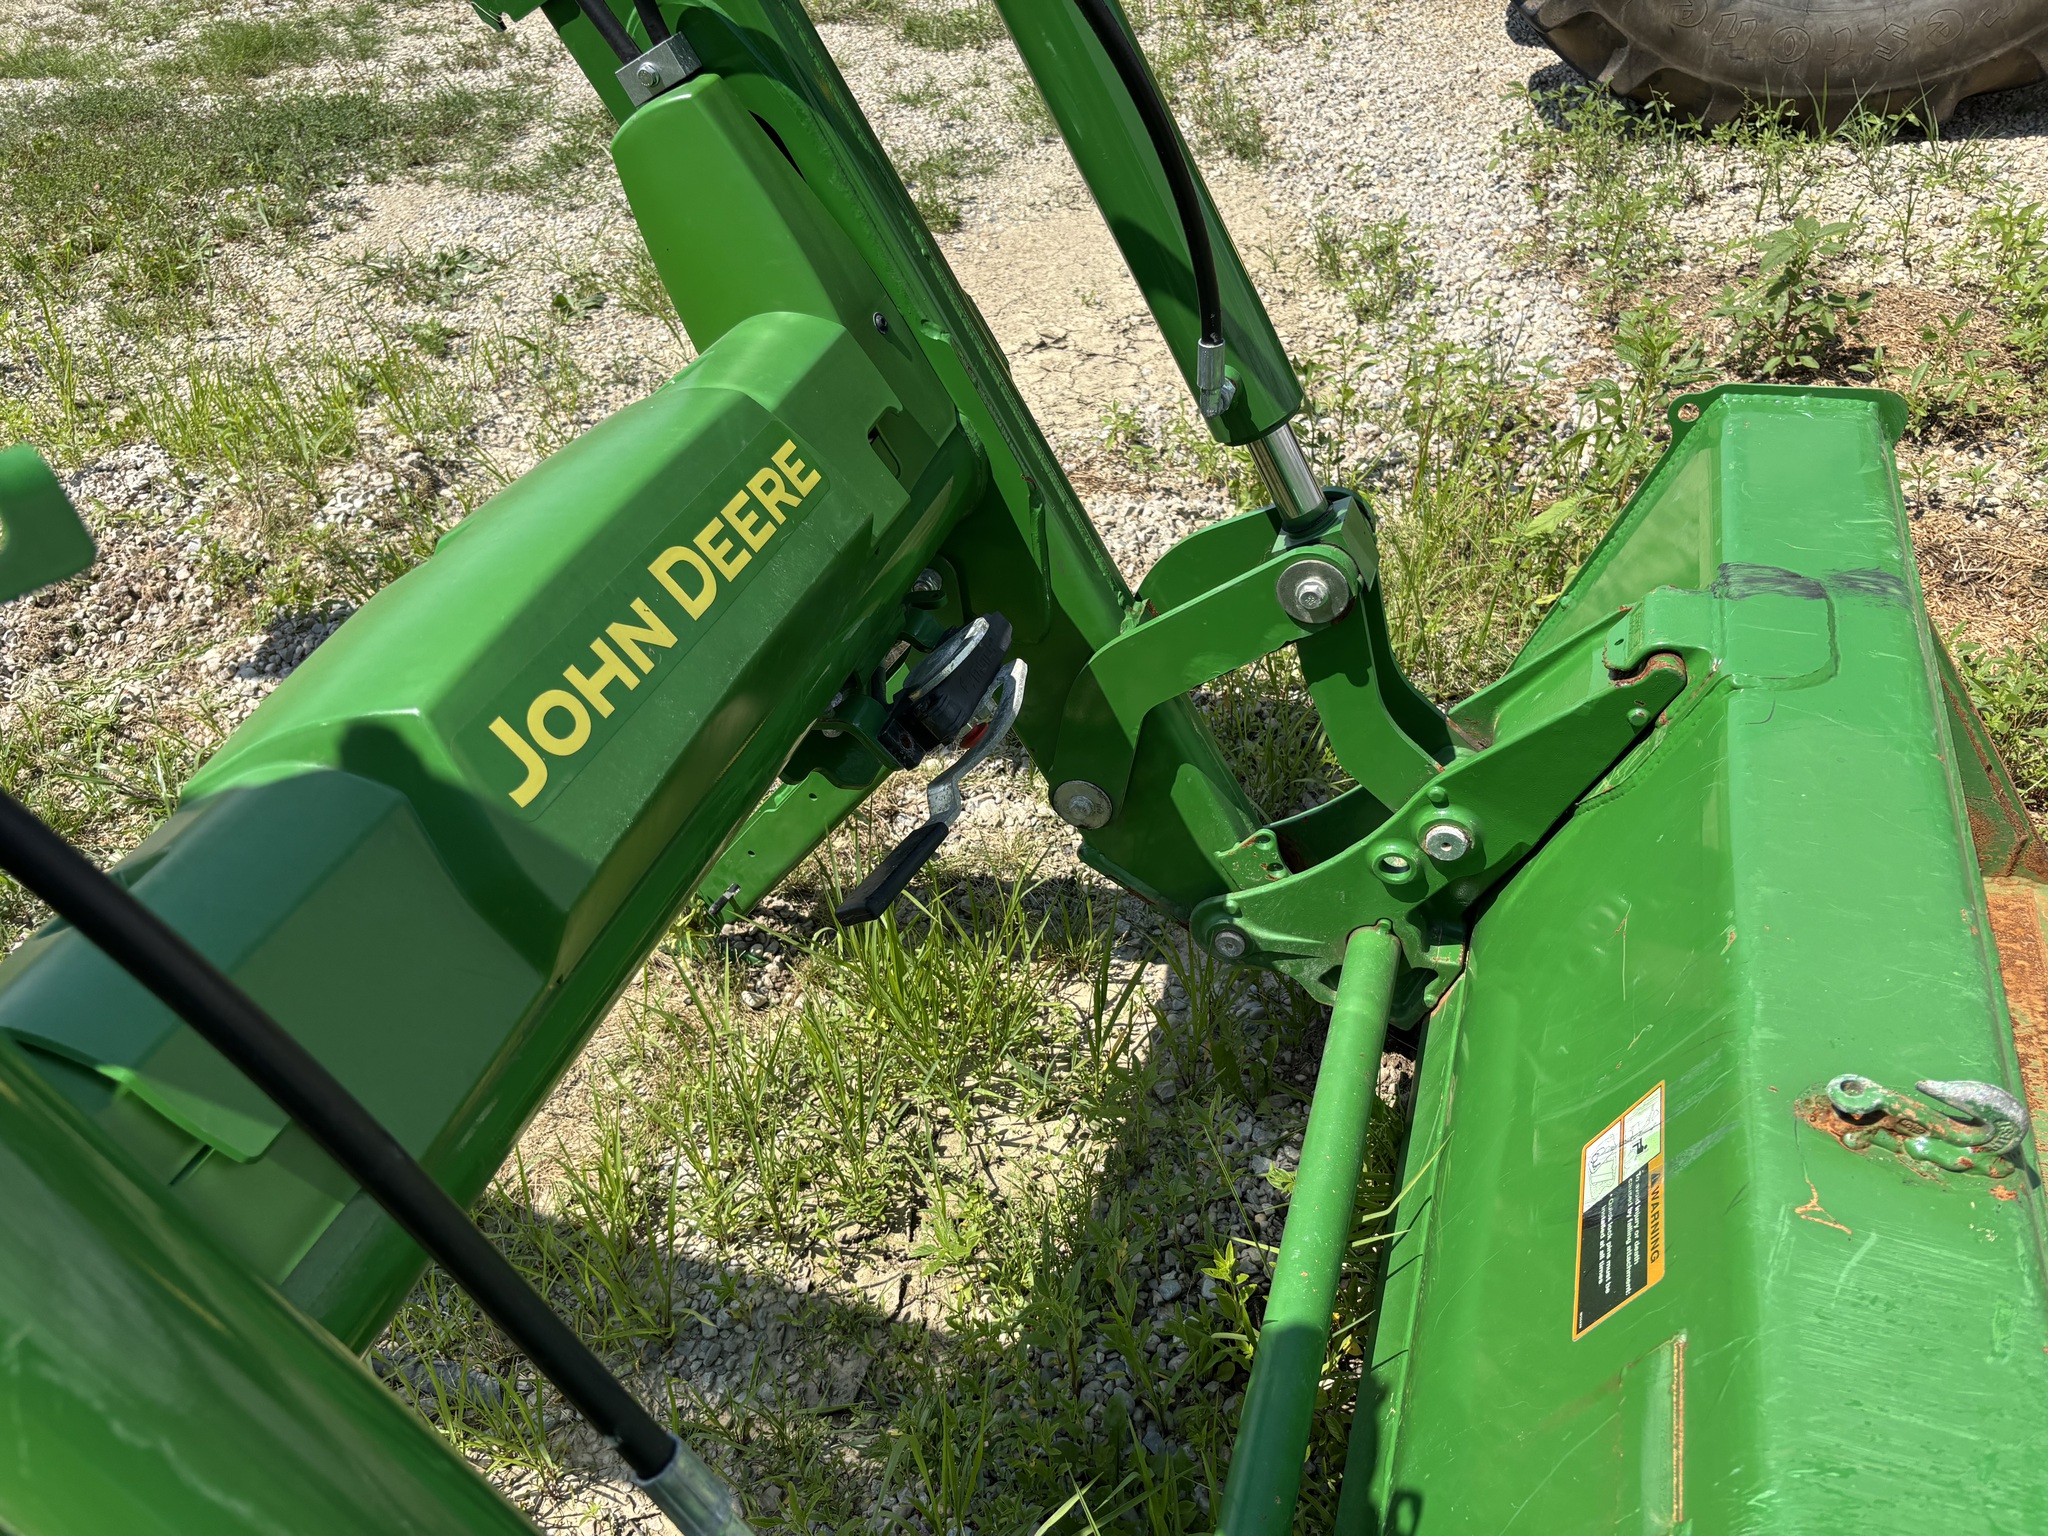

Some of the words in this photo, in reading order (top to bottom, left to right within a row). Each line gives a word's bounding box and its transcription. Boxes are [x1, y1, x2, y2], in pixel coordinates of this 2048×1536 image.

[488, 597, 679, 809] JOHN
[647, 438, 823, 621] DEERE
[1635, 1170, 1642, 1182] To
[1626, 1207, 1633, 1218] by
[1633, 1205, 1641, 1229] injury
[1606, 1222, 1614, 1241] lock
[1650, 1185, 1660, 1264] WARNING
[1633, 1230, 1640, 1239] or
[1605, 1241, 1613, 1259] pins
[1633, 1240, 1641, 1265] death
[1605, 1282, 1612, 1294] be
